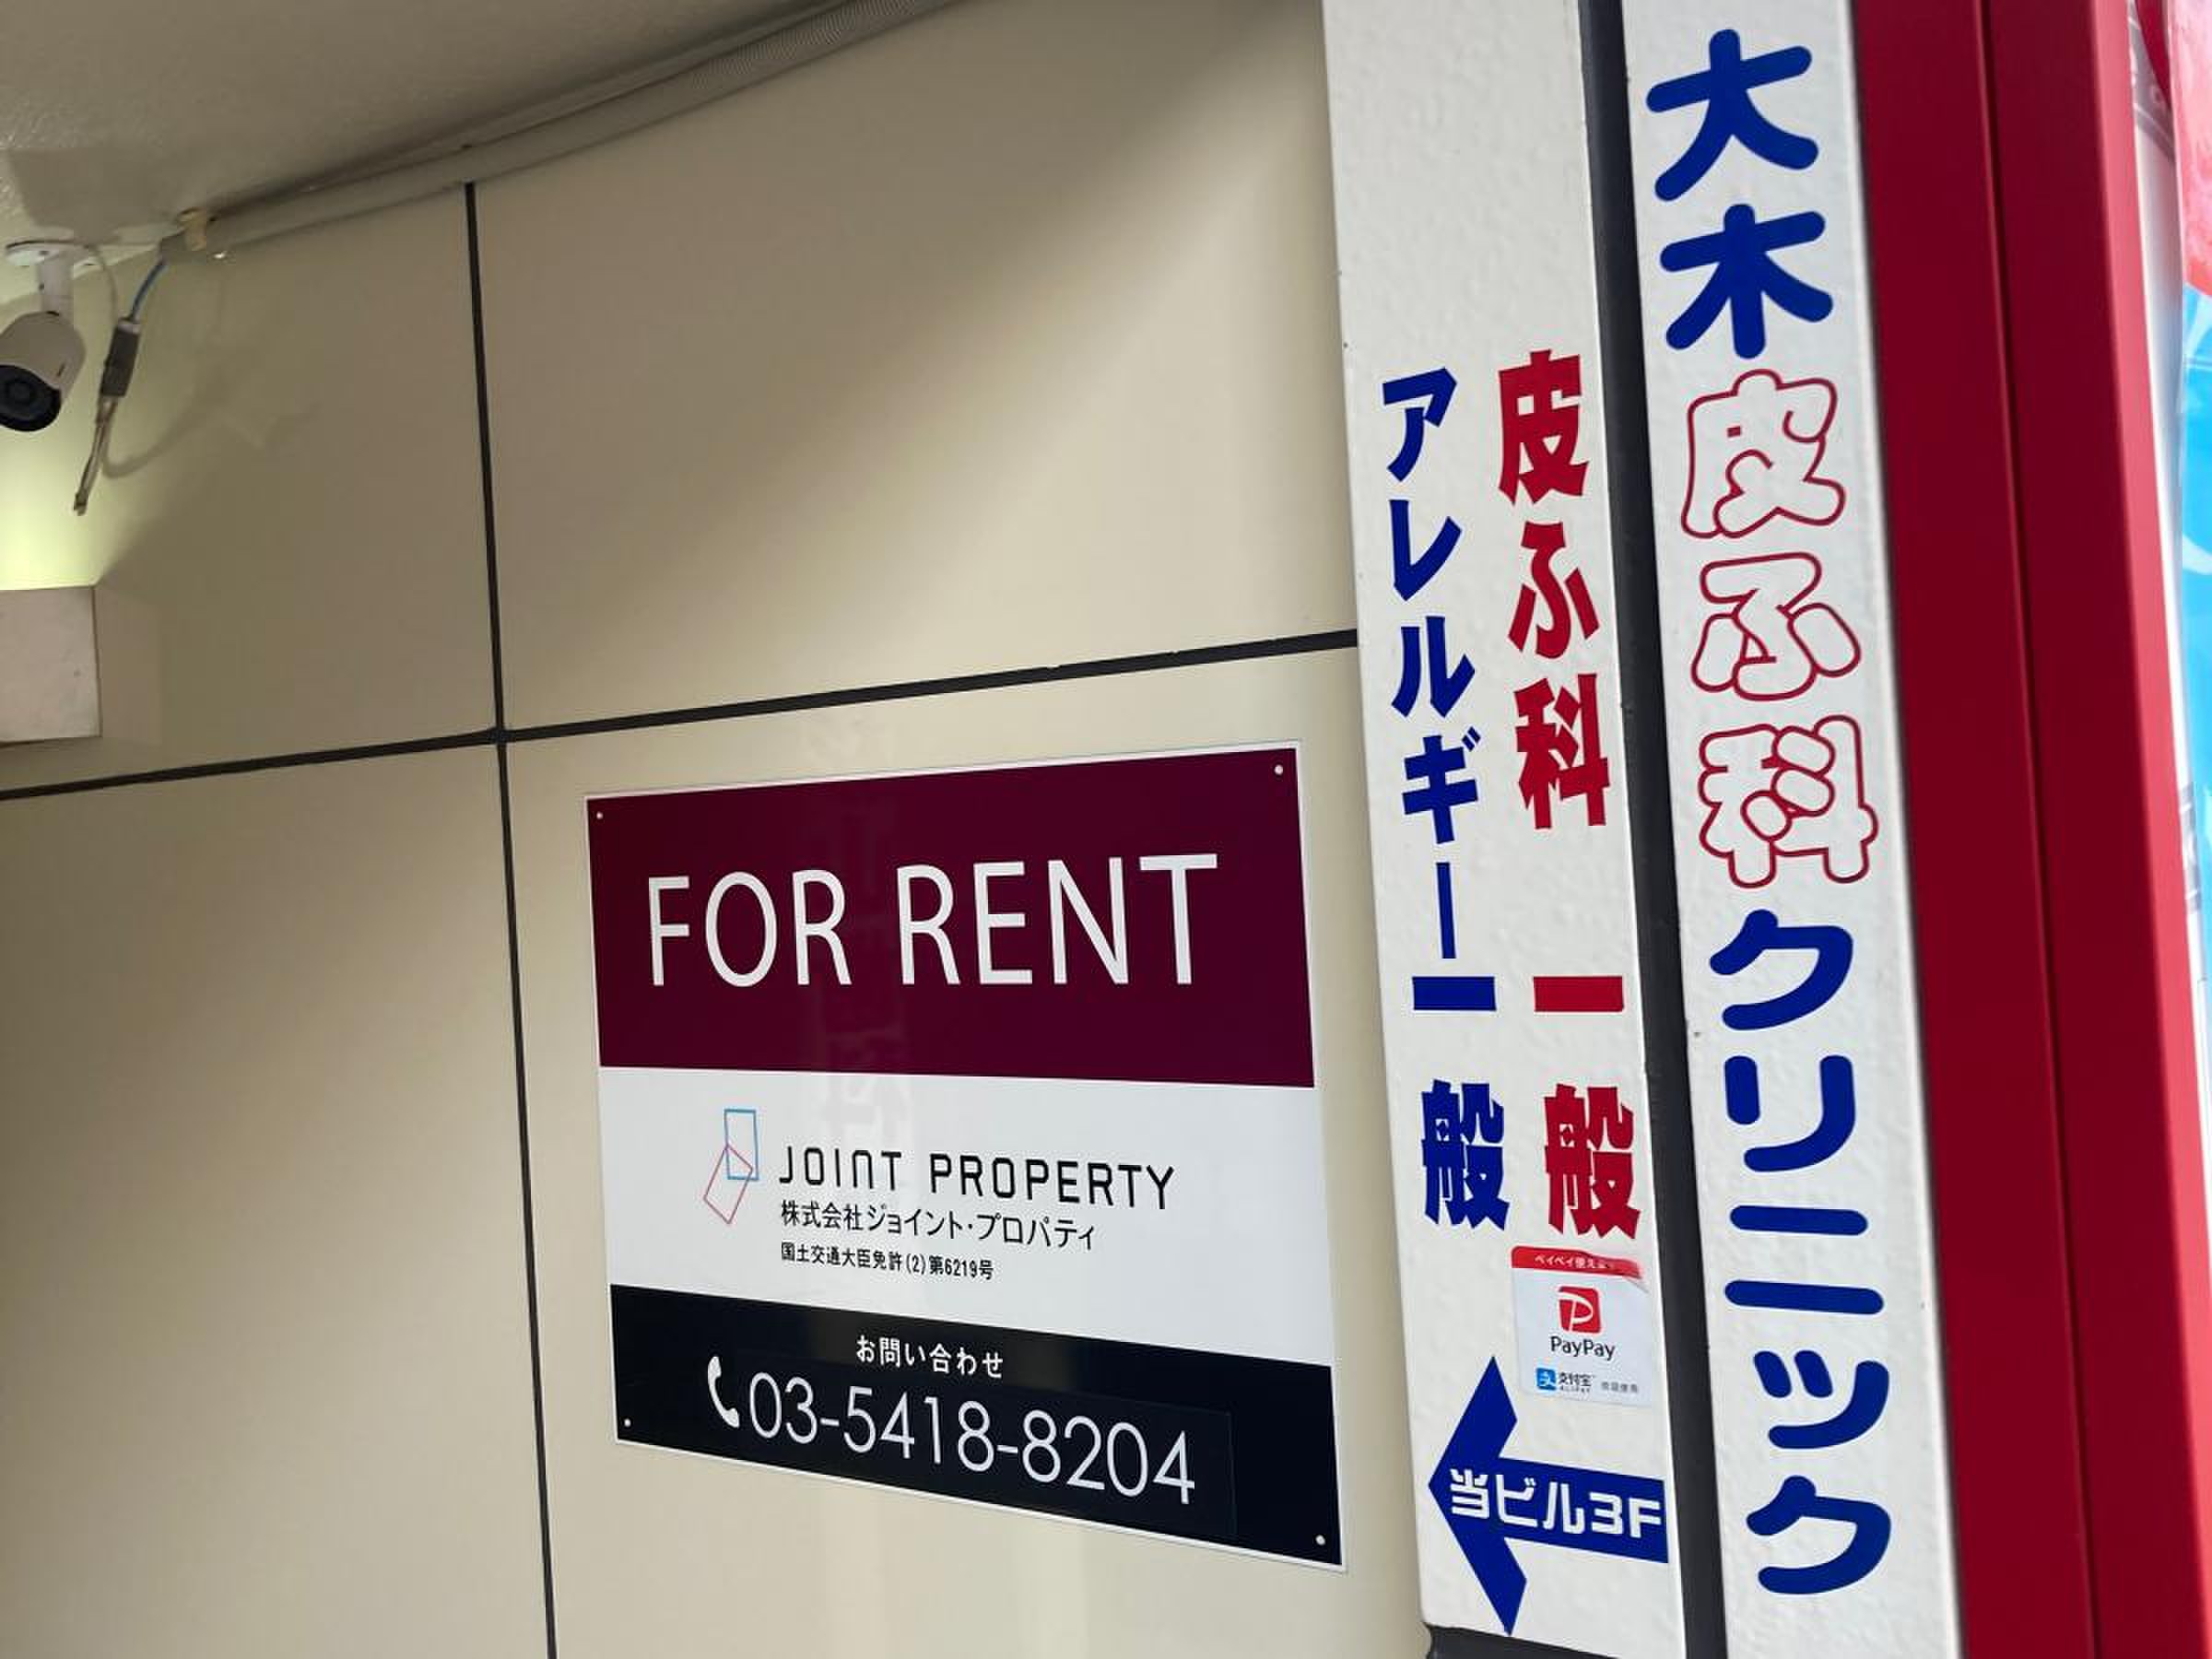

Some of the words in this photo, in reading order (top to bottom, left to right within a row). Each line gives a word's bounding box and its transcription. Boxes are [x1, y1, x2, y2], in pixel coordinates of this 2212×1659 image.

[1499, 349, 1610, 829] 皮ふ科
[1647, 29, 1892, 1594] 大木皮ふ科クリニック
[648, 869, 852, 986] FOR
[897, 853, 1218, 985] RENT
[1534, 975, 1641, 1239] 一般
[779, 1146, 902, 1191] JOINT
[929, 1153, 1175, 1210] PROPERTY
[781, 1199, 1096, 1251] 株式会社ジョイント・プロパティ
[856, 1334, 1005, 1380] お問い合わせ
[1550, 1335, 1616, 1361] PayPay
[748, 1371, 1195, 1505] 03-5418-8204
[1450, 1469, 1663, 1539] 当ビル3F
